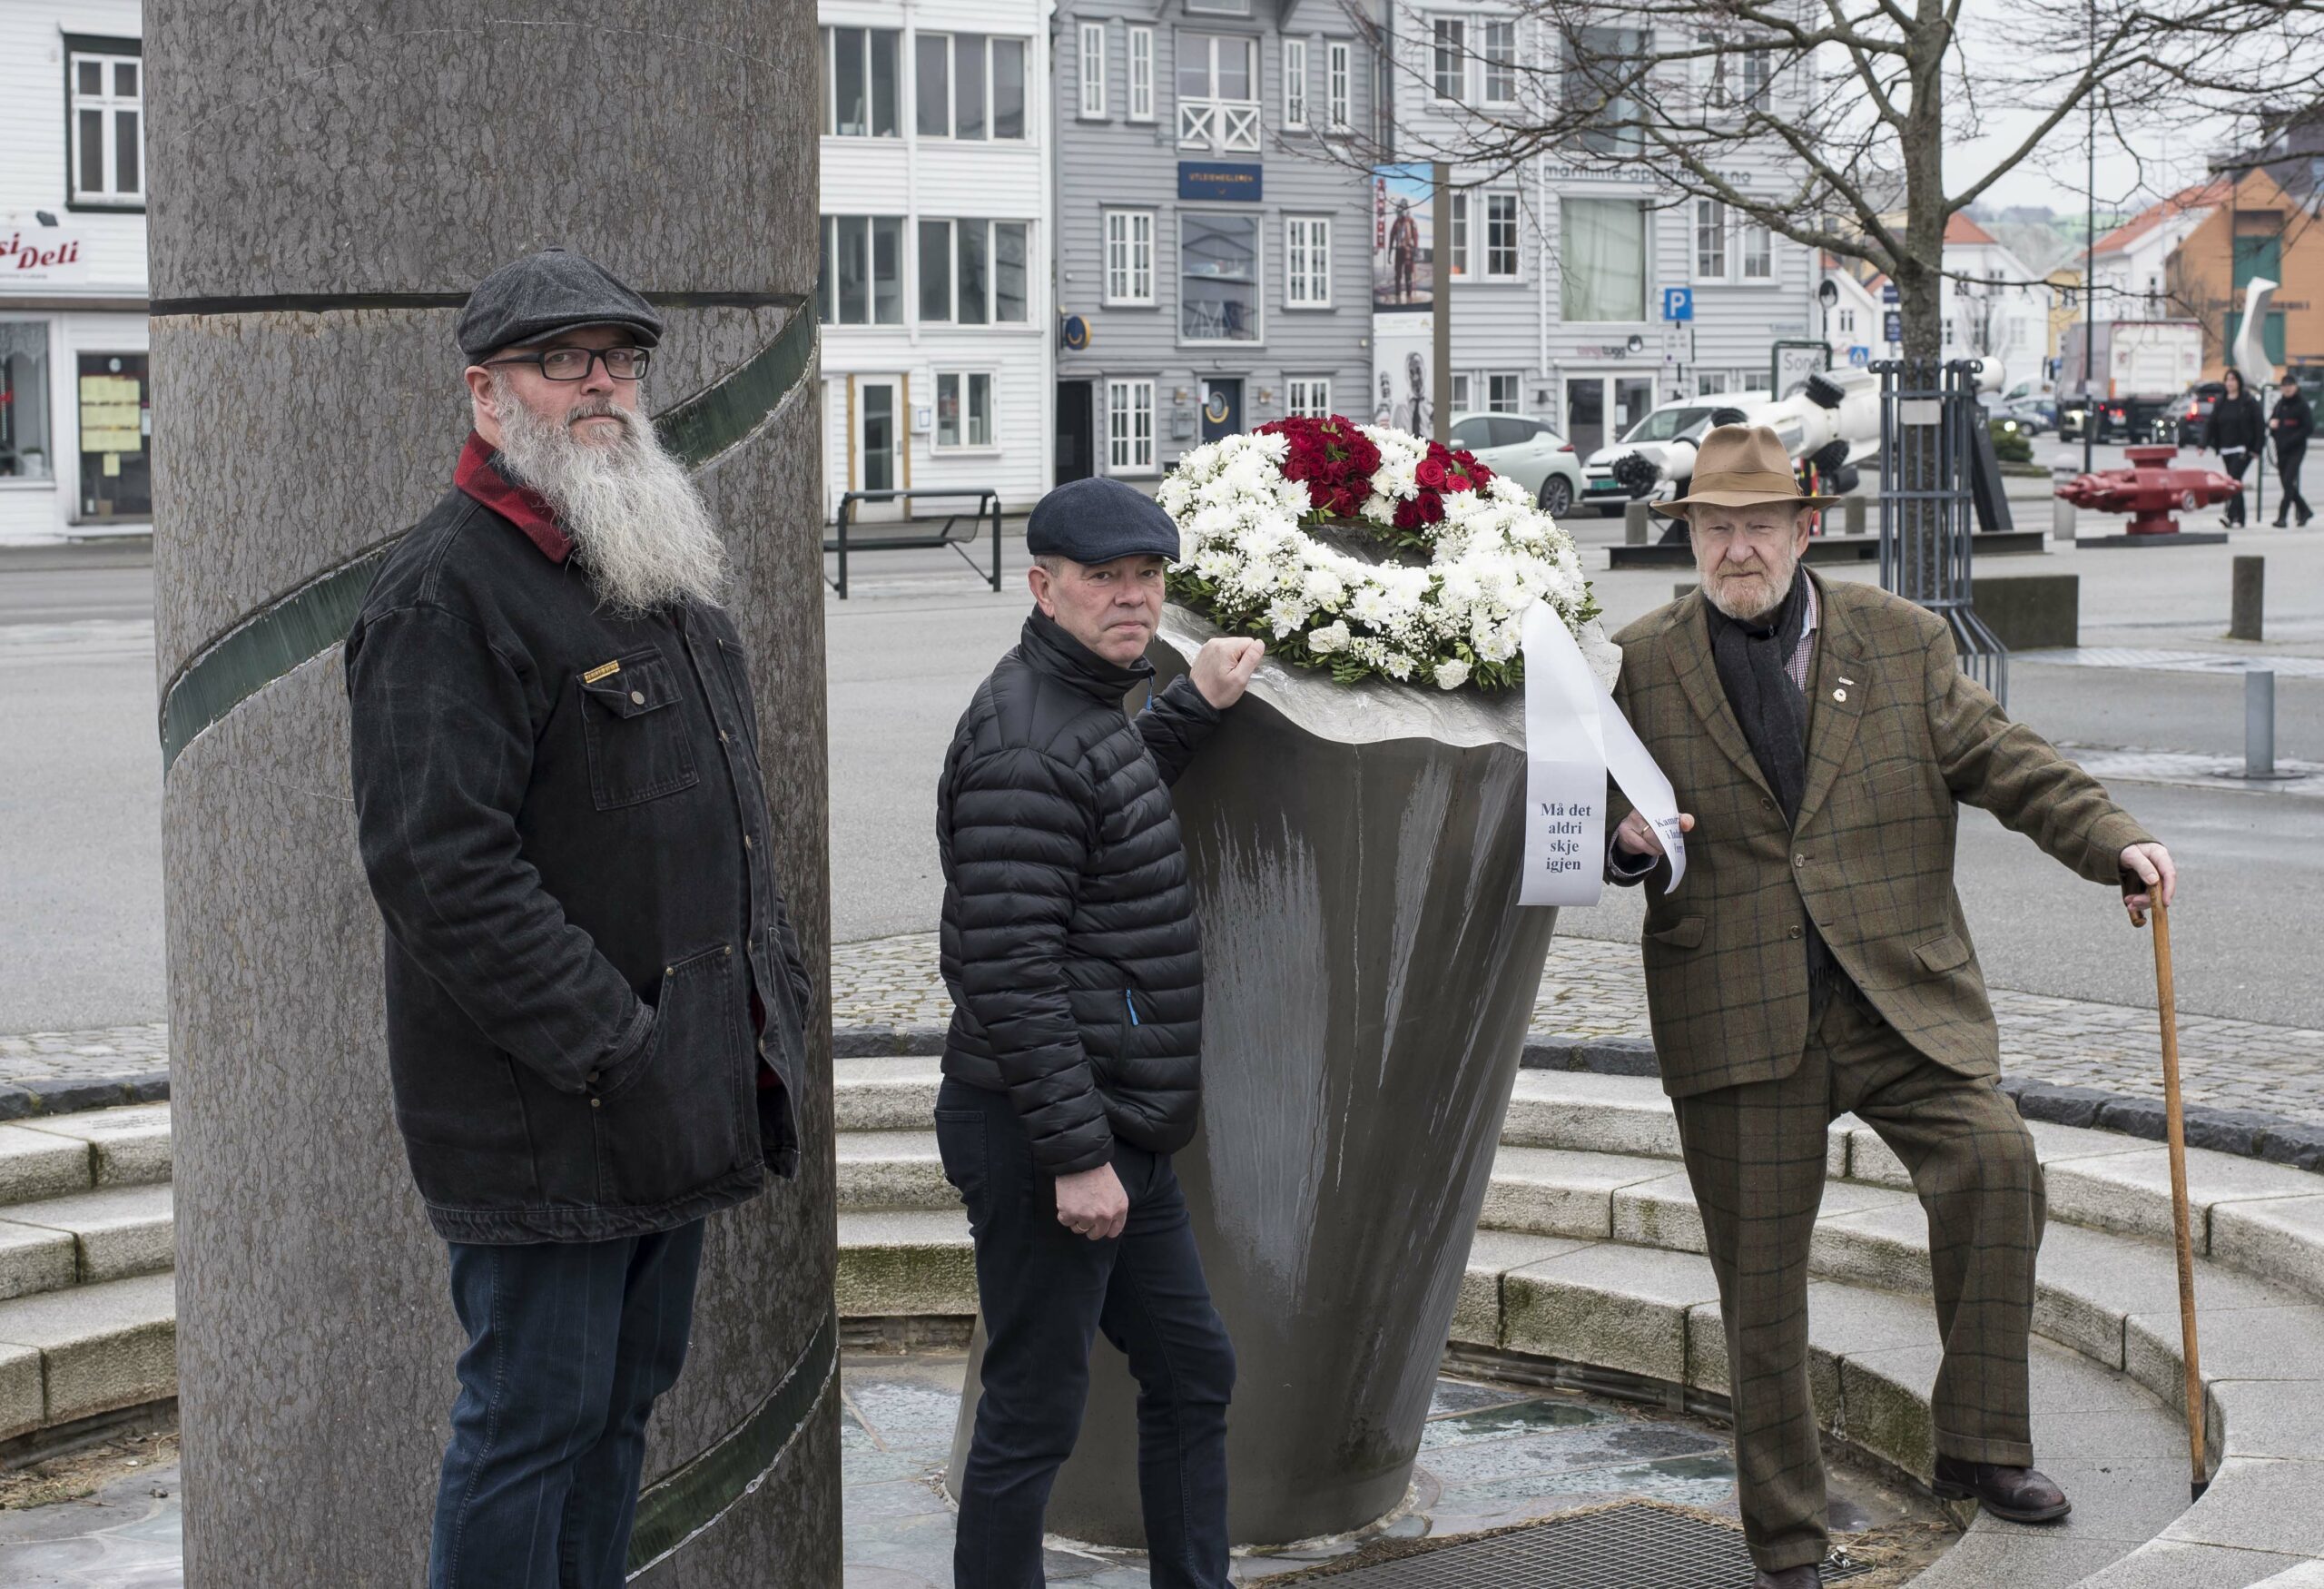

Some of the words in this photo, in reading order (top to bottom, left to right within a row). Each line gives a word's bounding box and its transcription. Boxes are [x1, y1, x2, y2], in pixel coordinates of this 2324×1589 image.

[17, 240, 79, 269] Deli
[1669, 291, 1686, 318] P
[1541, 803, 1564, 816] Må
[1569, 804, 1591, 816] det
[1548, 822, 1582, 834] aldri
[1550, 840, 1580, 856] skje
[1546, 857, 1581, 873] igjen
